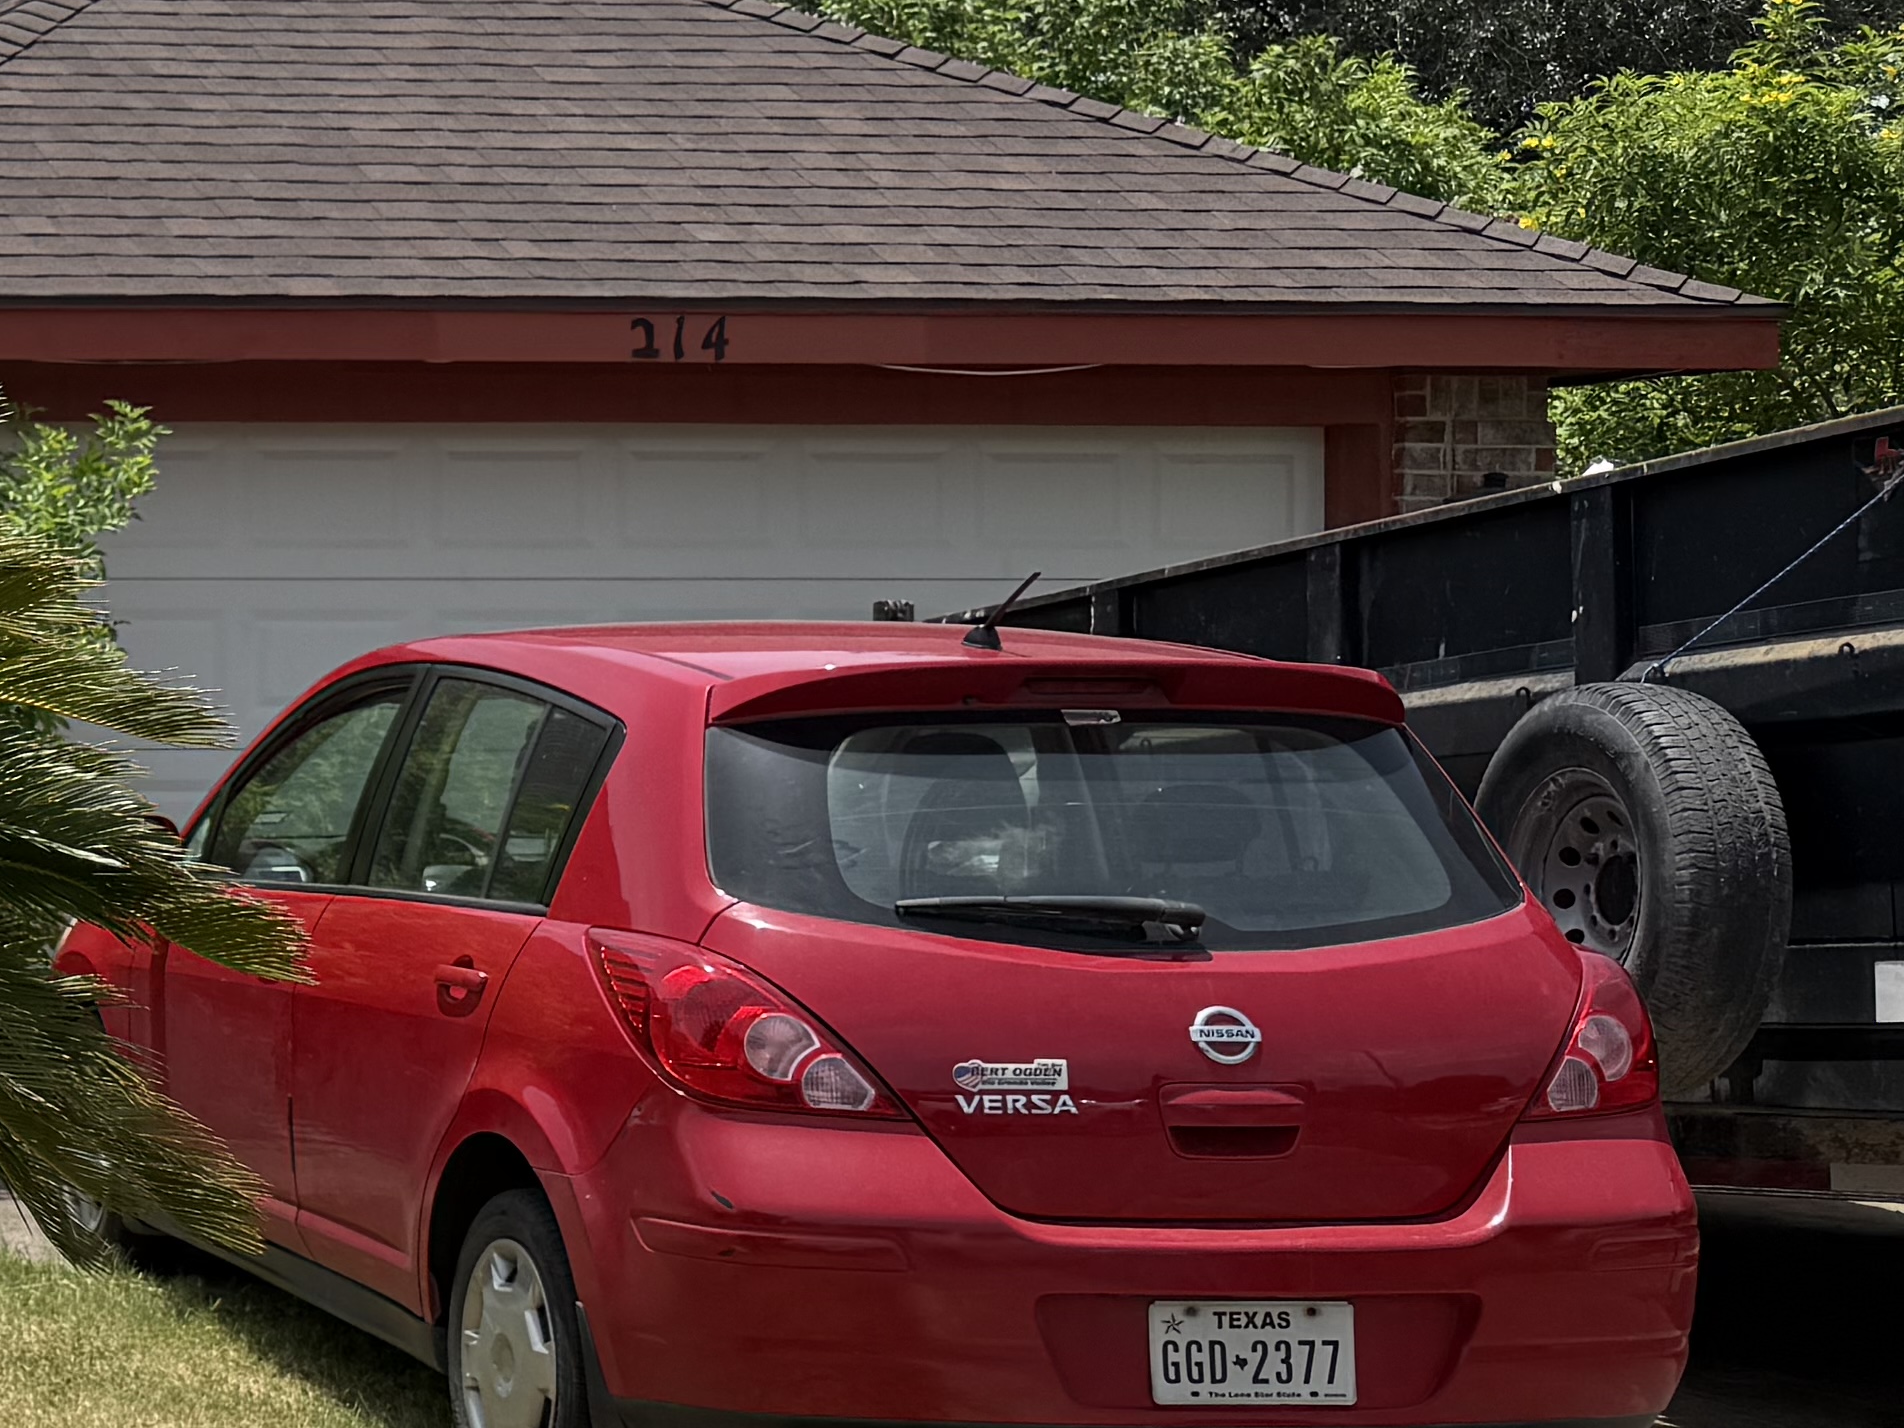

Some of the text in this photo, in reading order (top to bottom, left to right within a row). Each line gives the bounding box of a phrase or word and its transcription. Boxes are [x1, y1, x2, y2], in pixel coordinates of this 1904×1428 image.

[630, 315, 729, 361] 214
[1199, 1028, 1255, 1039] NISSAN
[1012, 1066, 1063, 1077] OGDEN
[954, 1094, 1080, 1115] VERSA
[1212, 1310, 1291, 1330] TEXAS
